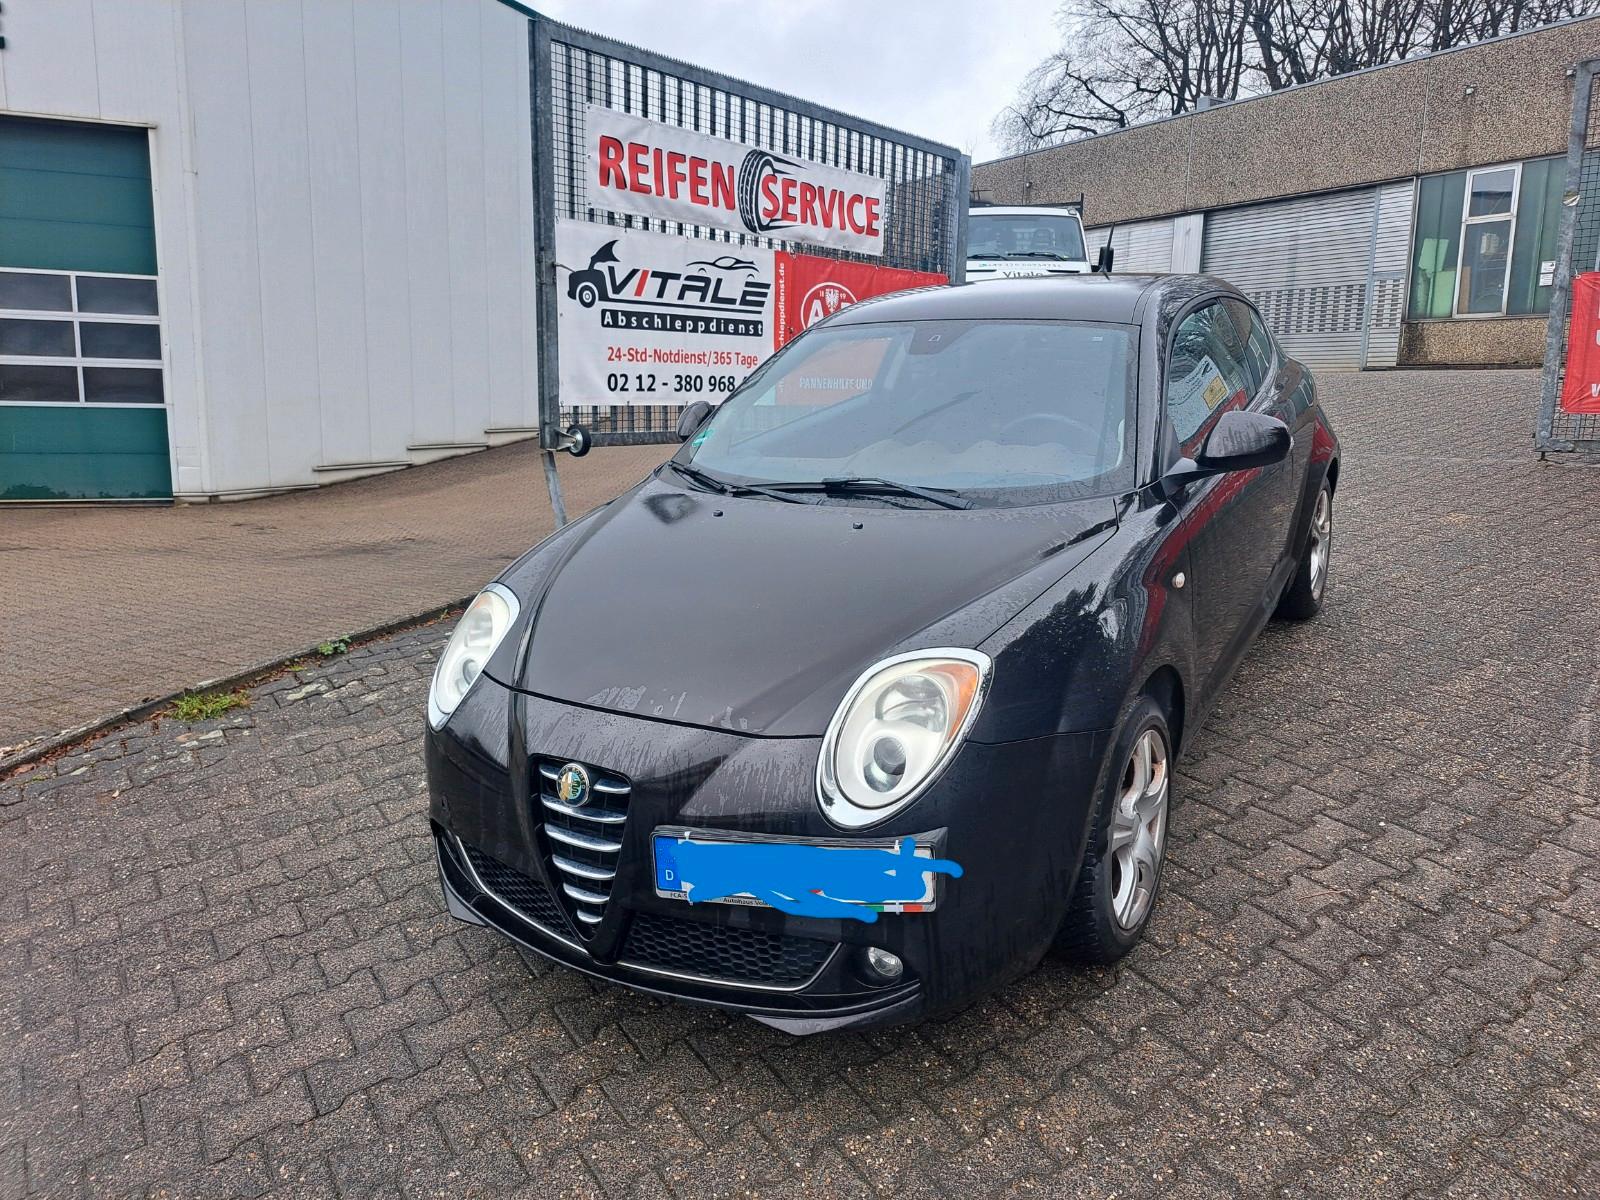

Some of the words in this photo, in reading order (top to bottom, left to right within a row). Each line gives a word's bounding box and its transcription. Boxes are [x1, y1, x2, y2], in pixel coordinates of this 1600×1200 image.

[599, 135, 736, 210] REIFEN
[761, 174, 880, 237] SERVICE
[607, 265, 771, 308] VITALE
[603, 311, 763, 335] Abschleppdienst
[607, 346, 732, 367] 24-Std-Notdienst/365
[735, 352, 758, 369] Tage
[607, 373, 629, 392] 02
[636, 373, 656, 392] 12
[674, 374, 703, 393] 380
[708, 375, 736, 393] 968
[665, 869, 674, 881] D
